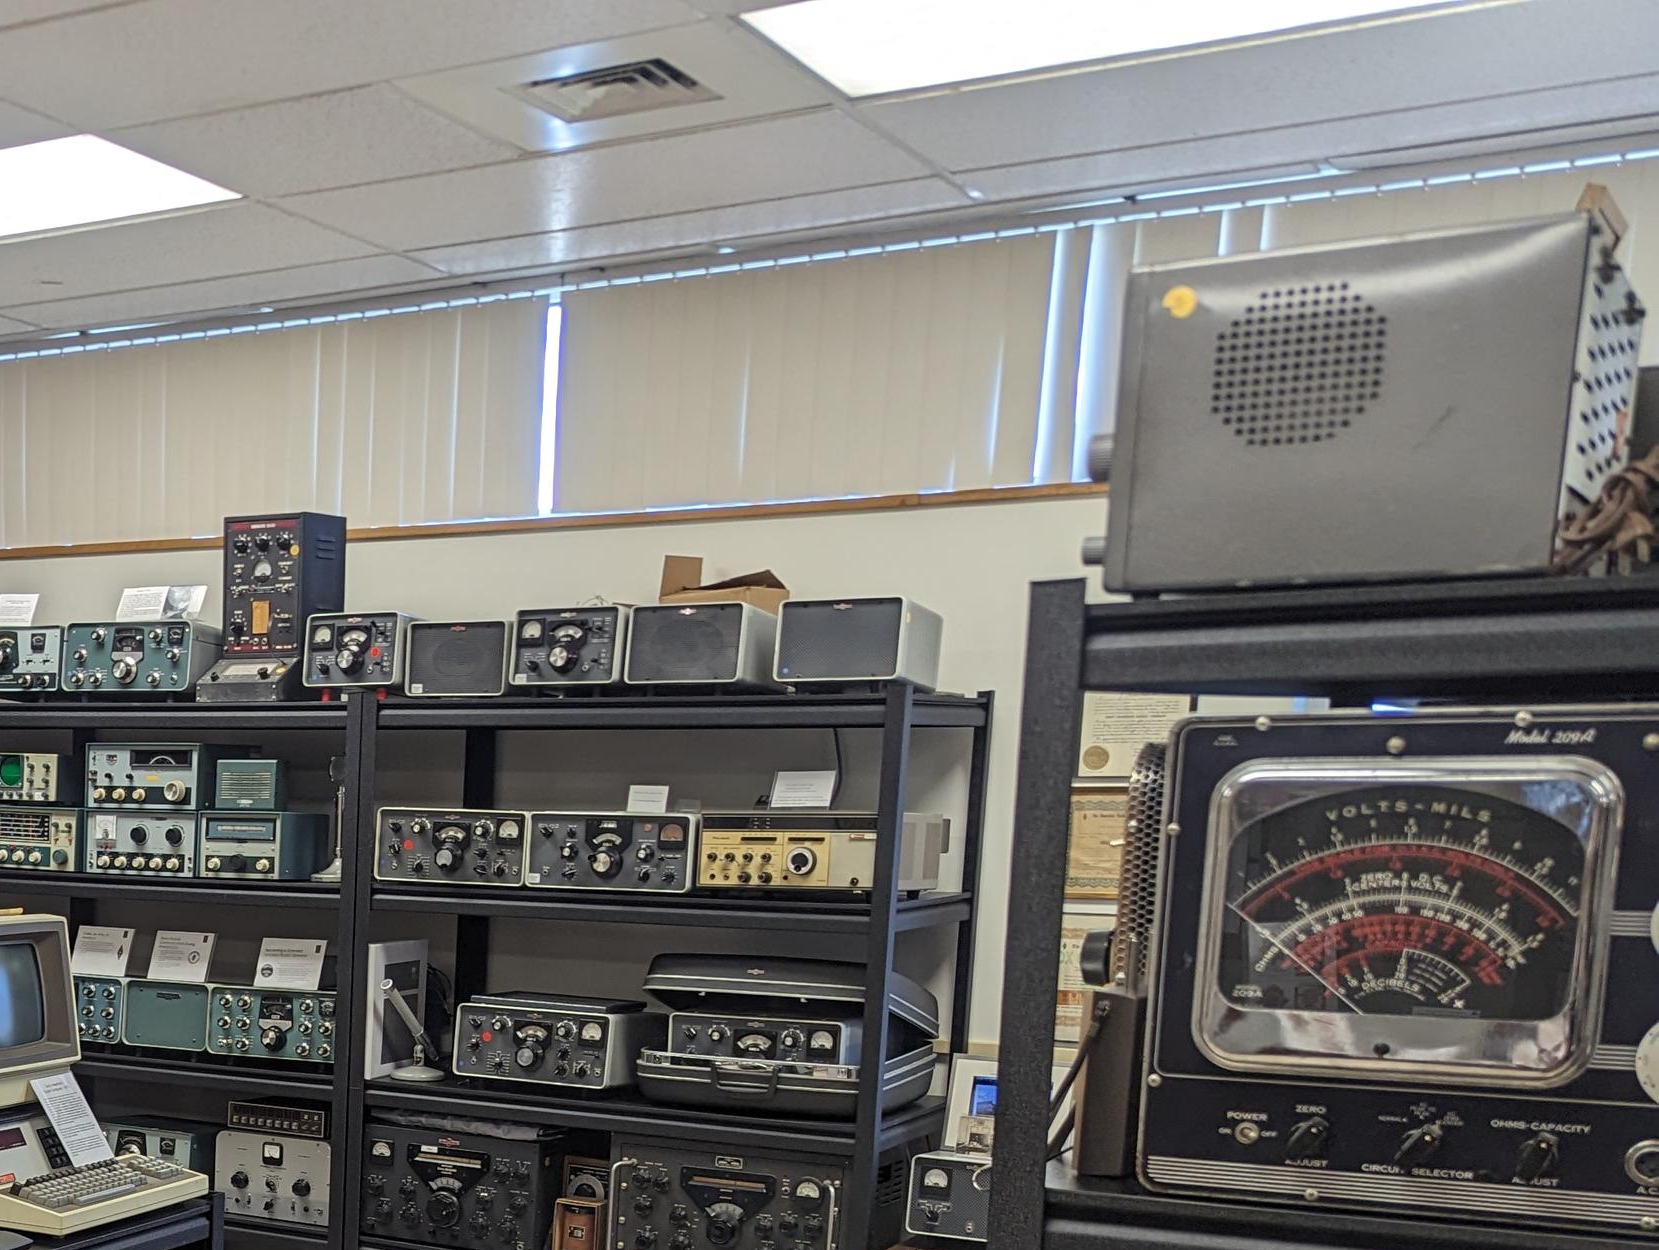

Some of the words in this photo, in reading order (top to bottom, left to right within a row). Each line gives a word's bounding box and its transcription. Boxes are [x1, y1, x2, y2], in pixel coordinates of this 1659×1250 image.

[1504, 730, 1547, 744] Model
[1552, 729, 1597, 744] 209A
[1360, 871, 1393, 880] ZERO
[1352, 879, 1401, 892] CENTER
[1410, 880, 1449, 893] VOLTS
[1254, 946, 1279, 972] OHMS
[1362, 979, 1420, 992] DECIBELS
[1295, 1104, 1327, 1115] ZERO
[1226, 1111, 1268, 1122] POWER
[1490, 1119, 1592, 1134] OHMS-CAPACITY
[1260, 1130, 1278, 1138] OFF
[1411, 1167, 1474, 1180] SELECTOR
